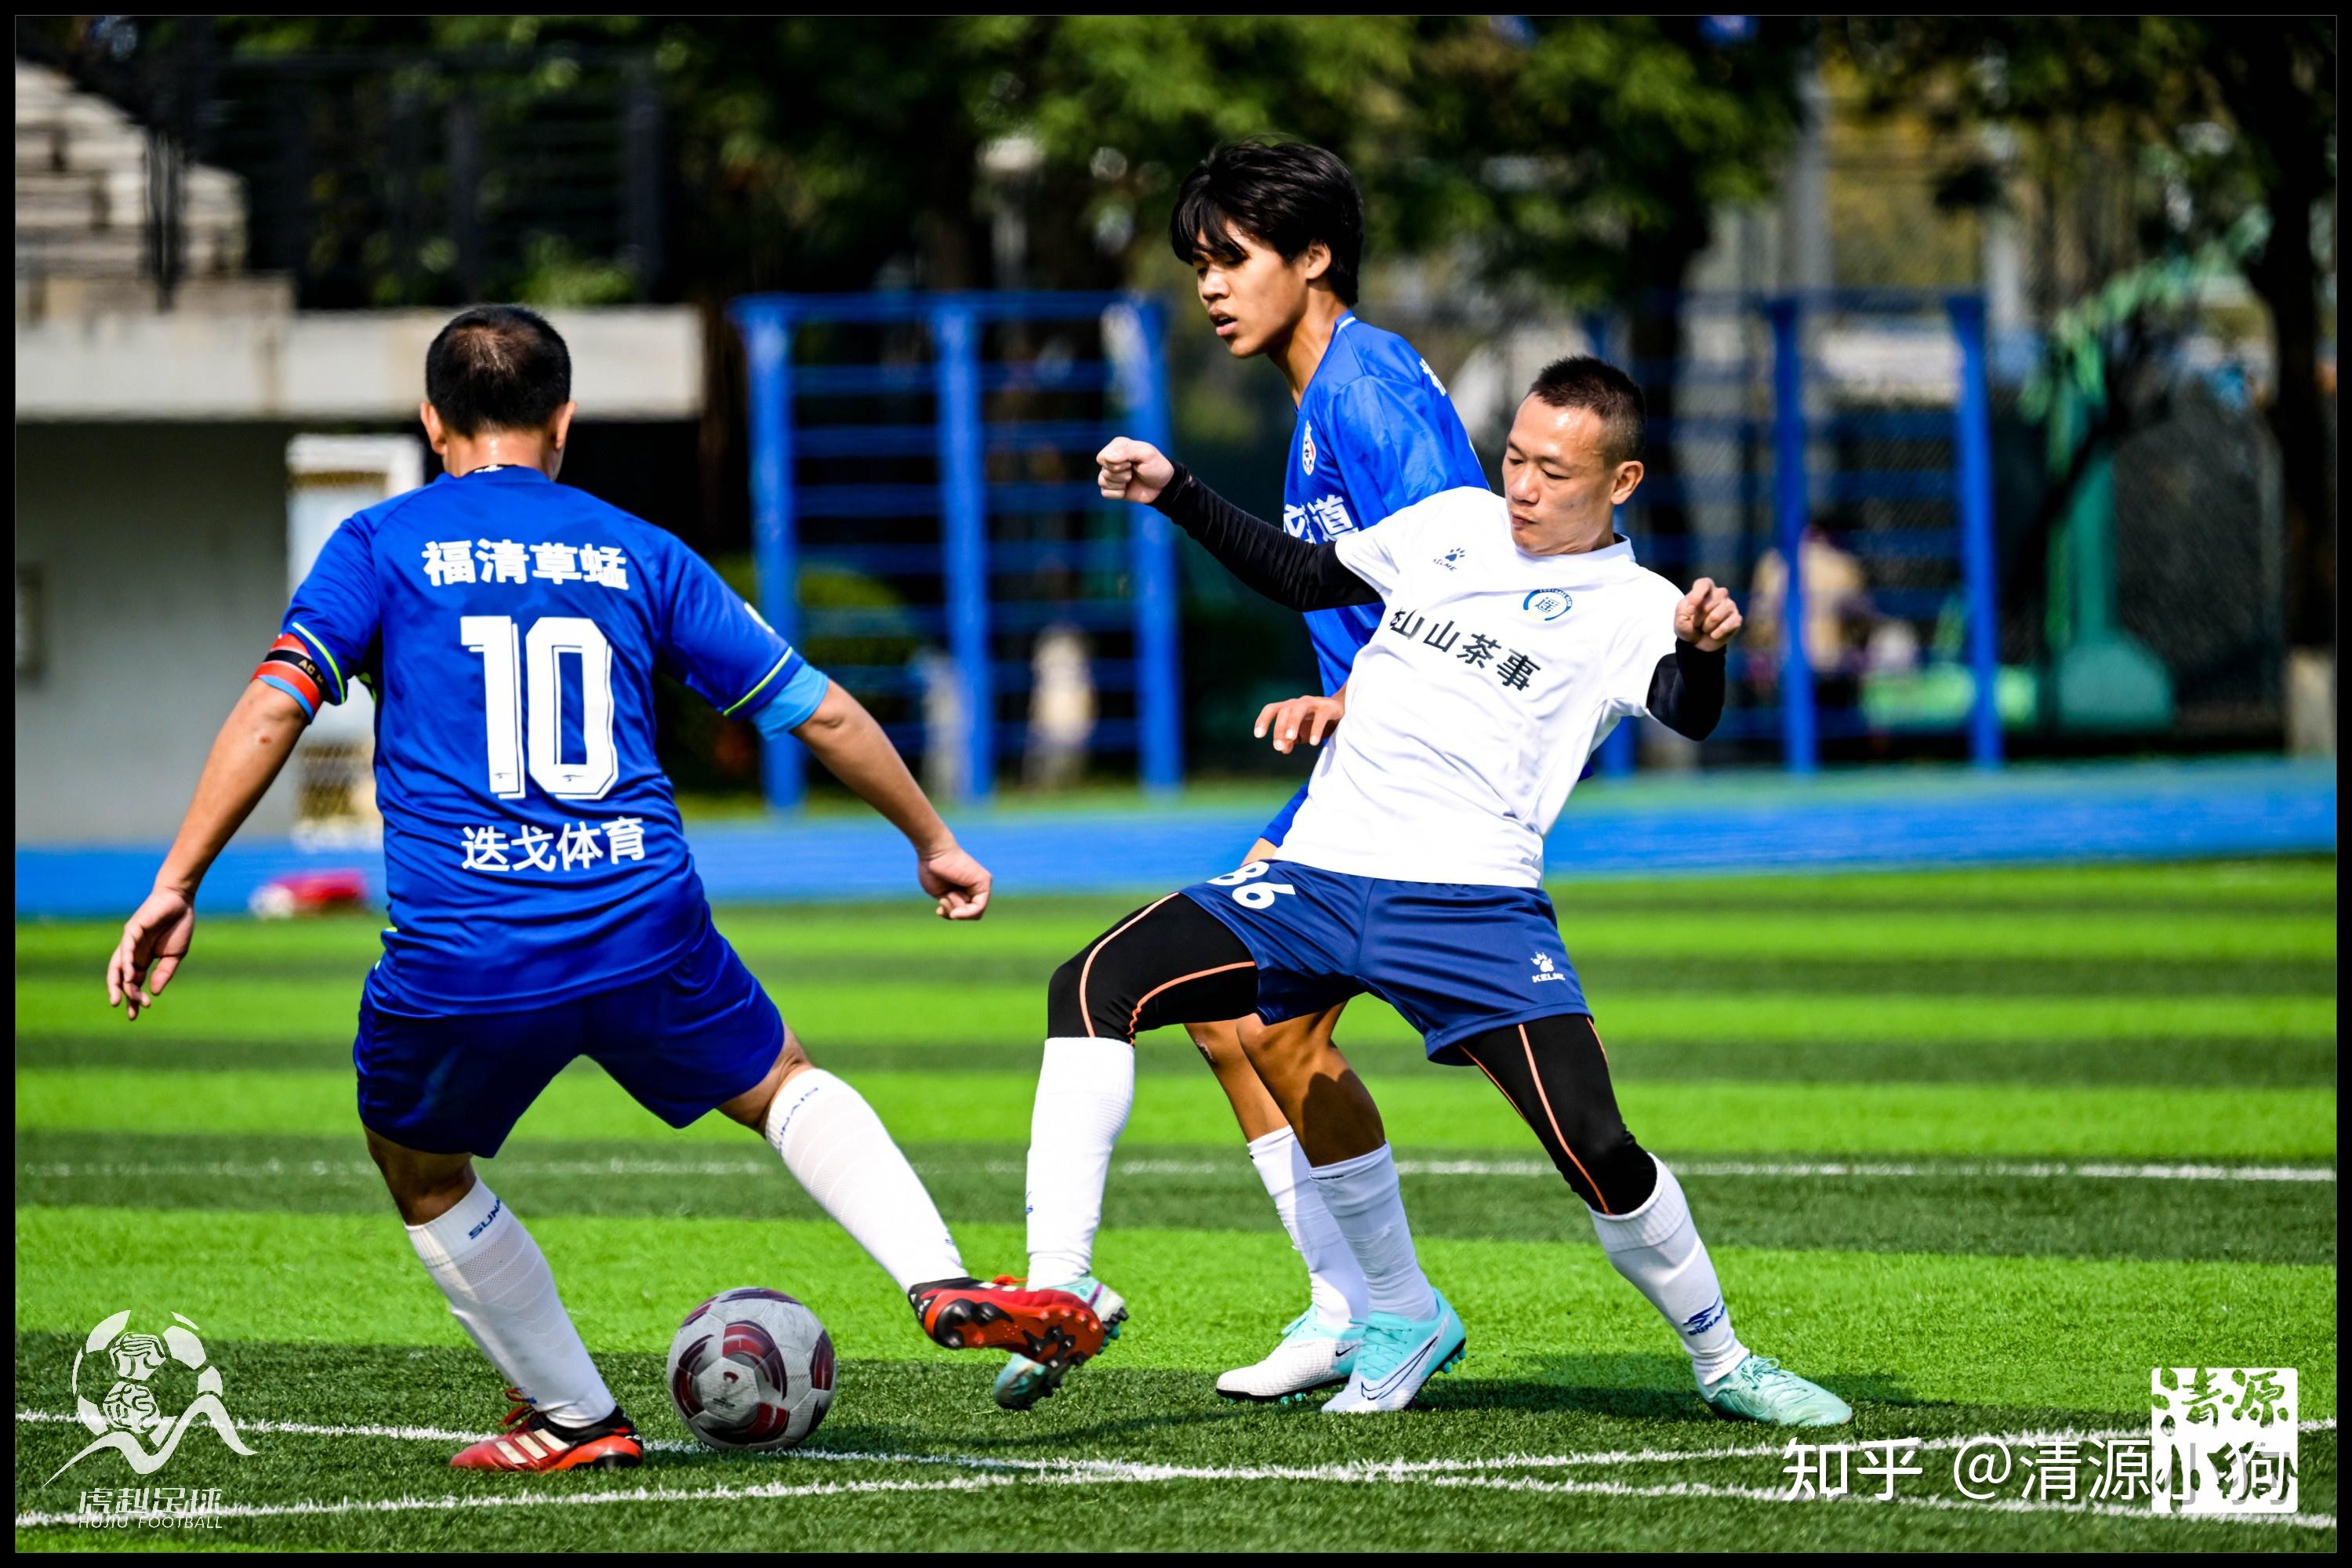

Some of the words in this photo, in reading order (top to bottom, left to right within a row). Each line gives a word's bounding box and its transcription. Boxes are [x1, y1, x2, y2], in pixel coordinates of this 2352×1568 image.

[422, 538, 630, 590] 福清草蜢
[461, 615, 619, 800] 10
[461, 816, 645, 872] 迭戈体育
